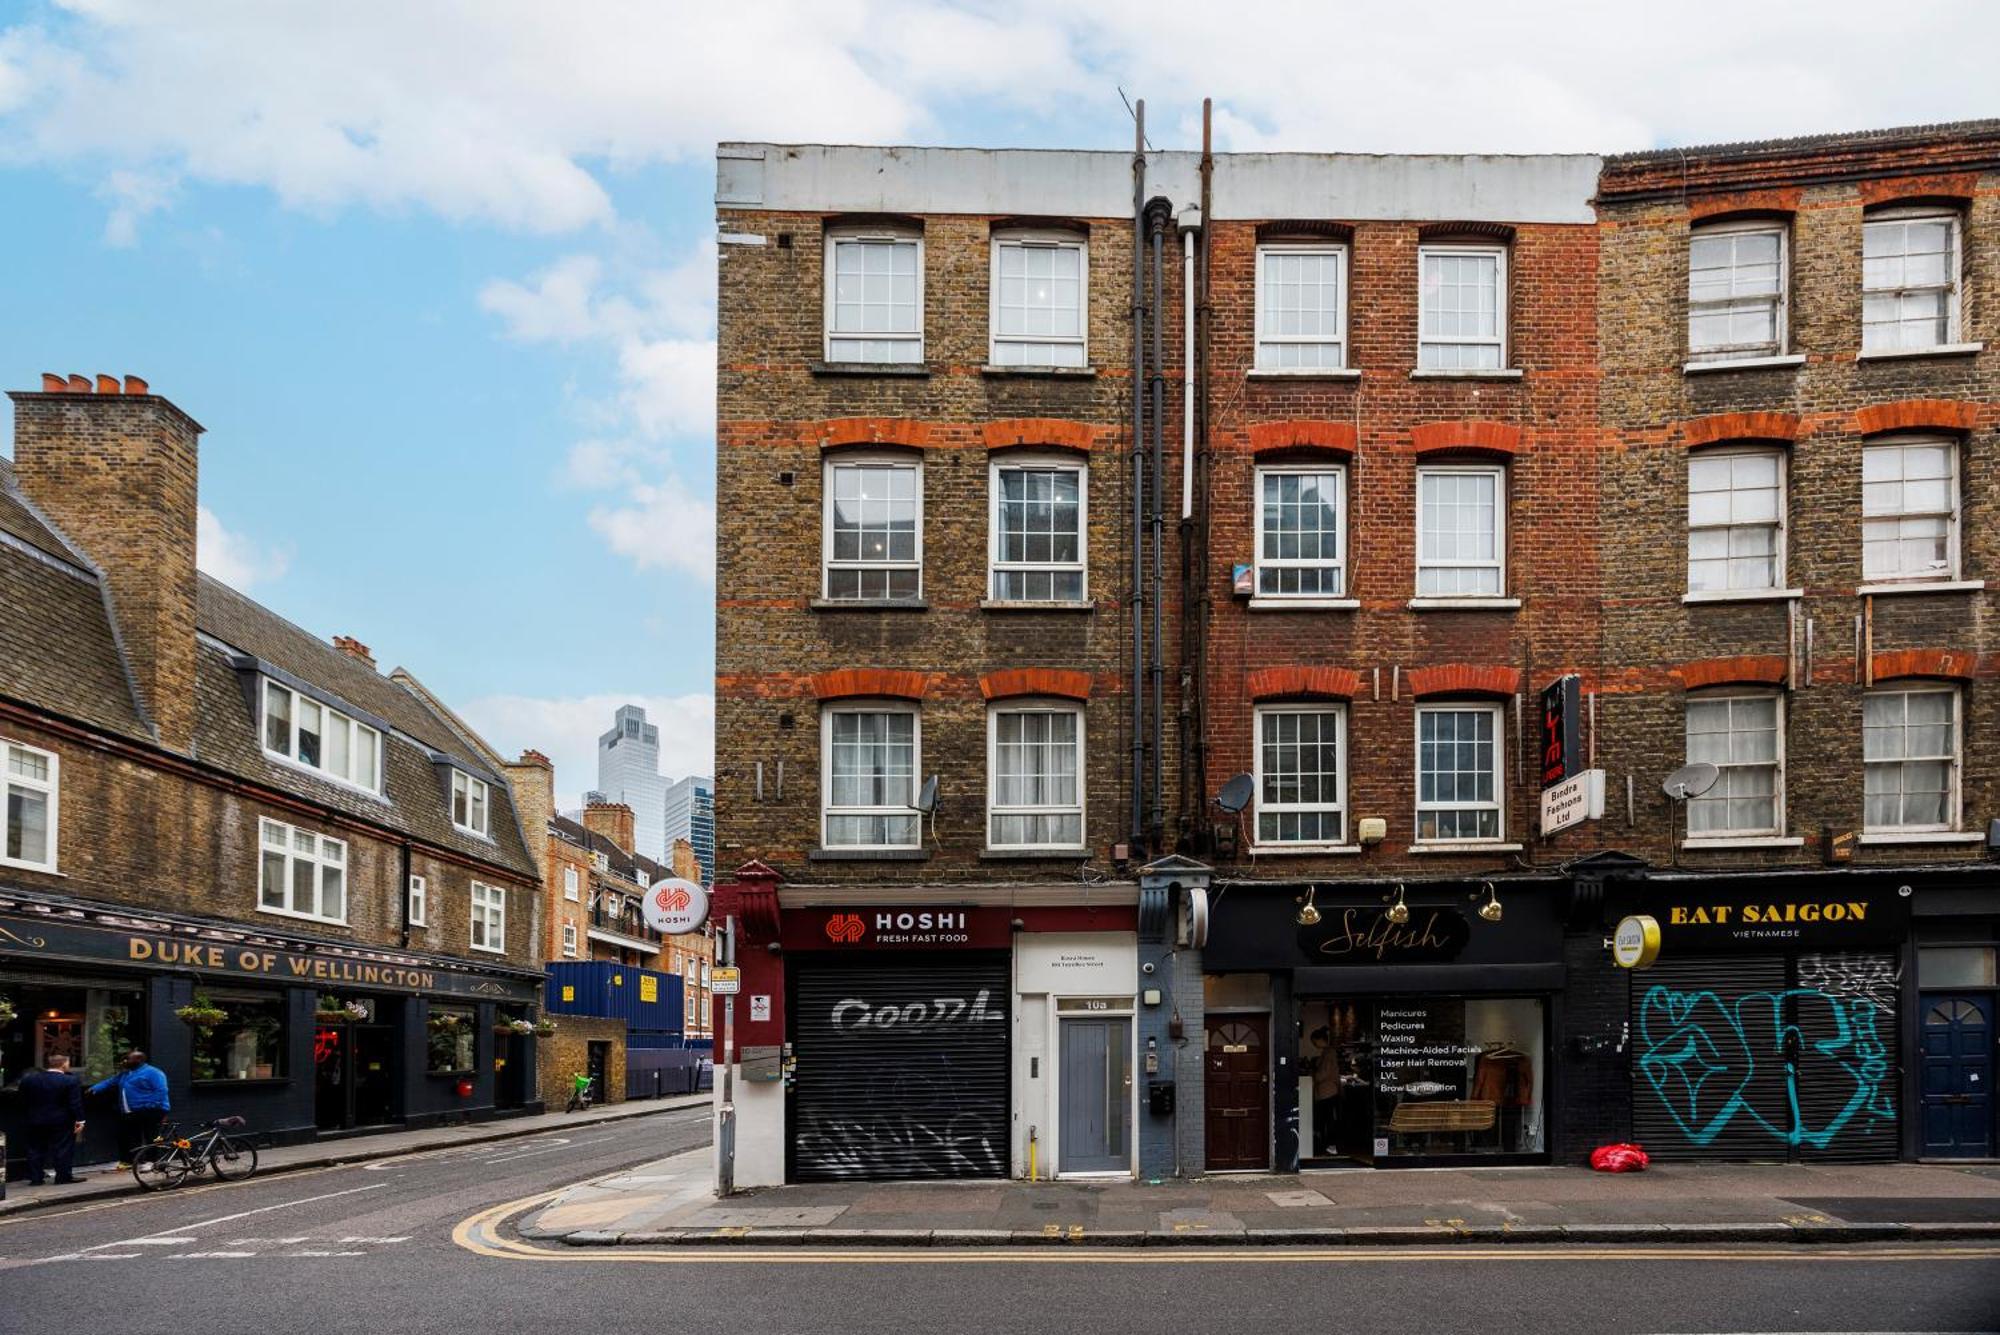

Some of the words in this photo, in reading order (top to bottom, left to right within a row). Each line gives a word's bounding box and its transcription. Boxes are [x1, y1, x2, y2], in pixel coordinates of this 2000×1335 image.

[1551, 784, 1577, 802] Bindra
[1546, 794, 1582, 816] Fashions
[1556, 810, 1570, 824] Ltd
[1670, 906, 1733, 925] EAT
[1742, 902, 1868, 923] SAIGON
[876, 912, 965, 930] HOSHI
[876, 934, 909, 943] FRESH
[911, 934, 937, 943] FAST
[939, 934, 968, 943] FOOD
[1320, 908, 1450, 960] Selfish
[1732, 930, 1800, 938] VIETNAMESE
[128, 938, 225, 968] DUKE
[239, 951, 277, 972] OF
[288, 956, 433, 988] WELLINGTON
[1085, 1000, 1107, 1010] 10a
[1380, 1009, 1427, 1018] Manicures
[1380, 1021, 1425, 1030] Pedicures
[1380, 1033, 1416, 1044] Waxing
[1380, 1046, 1448, 1055] Machine-Aided
[1451, 1045, 1482, 1054] Facials
[1380, 1059, 1405, 1068] Laser
[1407, 1058, 1425, 1067] Hair
[1427, 1058, 1467, 1067] Removal
[1380, 1071, 1398, 1080] LVL
[1380, 1083, 1405, 1092] Brow
